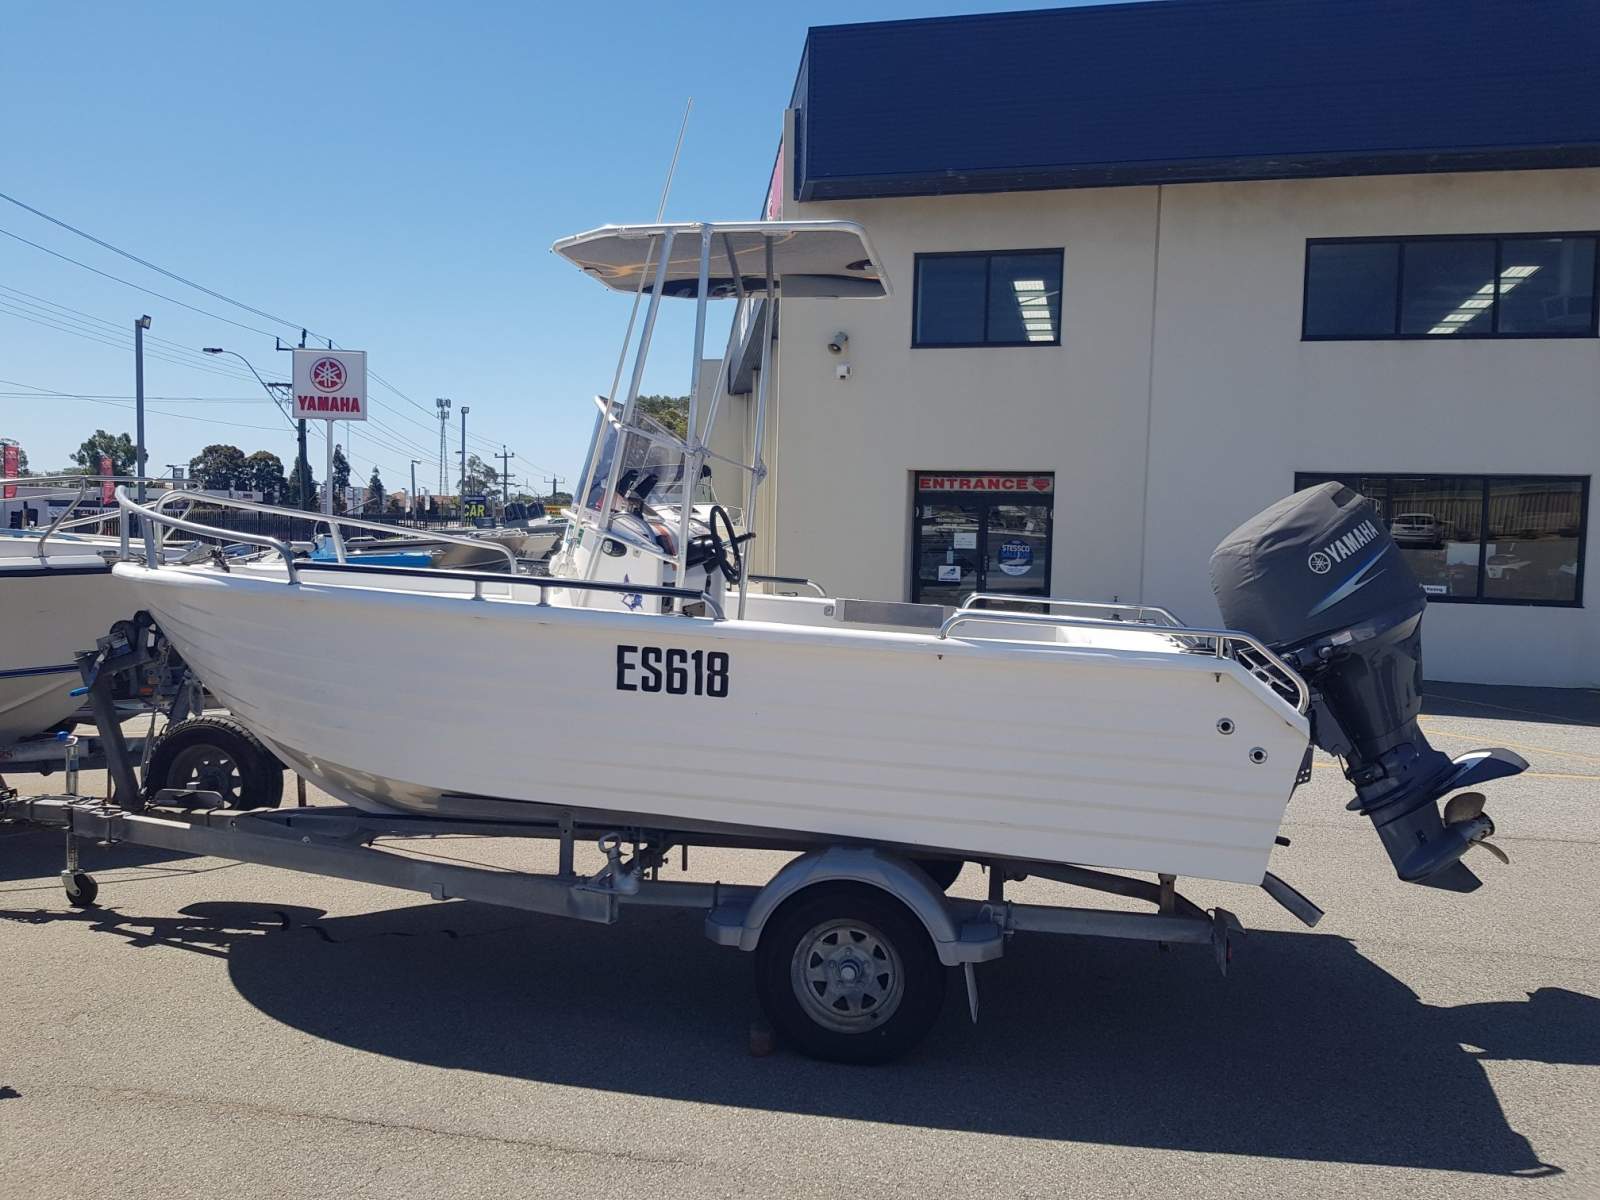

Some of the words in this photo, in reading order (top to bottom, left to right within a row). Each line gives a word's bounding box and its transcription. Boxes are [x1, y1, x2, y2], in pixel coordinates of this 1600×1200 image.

[298, 395, 361, 412] YAMAHA
[919, 478, 1029, 490] ENTRANCE
[1323, 519, 1380, 563] YAMAHA
[616, 644, 730, 698] ES618
